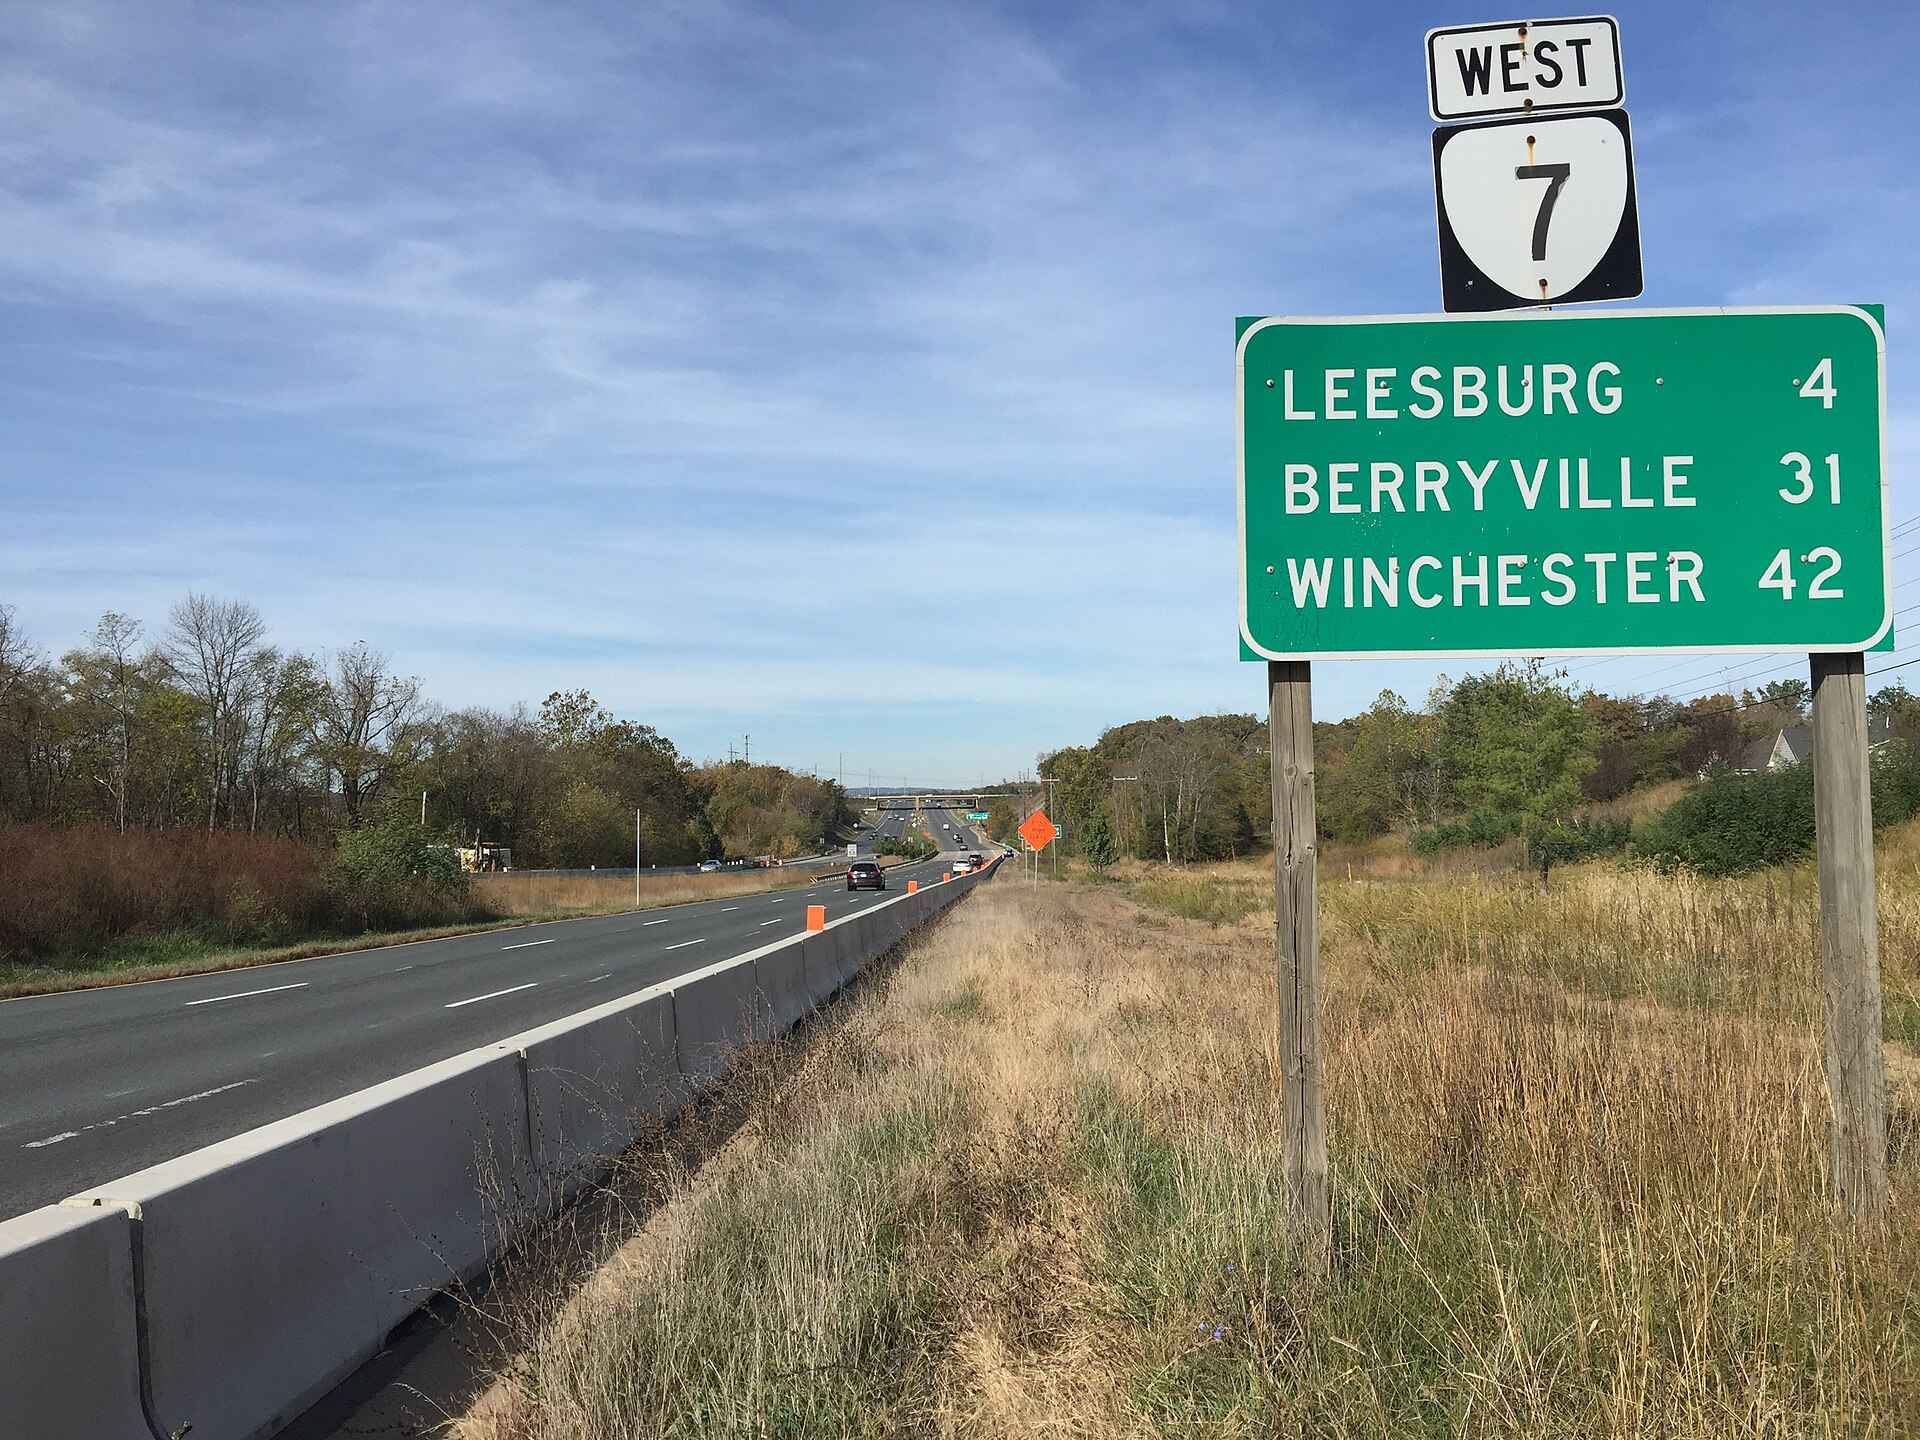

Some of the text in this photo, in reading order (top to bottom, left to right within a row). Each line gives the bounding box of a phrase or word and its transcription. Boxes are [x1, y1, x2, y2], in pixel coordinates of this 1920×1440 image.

[1455, 38, 1592, 96] WEST
[1515, 163, 1570, 261] 7
[1285, 358, 1837, 420] LEESBURG 4
[1285, 452, 1840, 514] BERRYVILLE 31
[1287, 547, 1843, 608] WINCHESTER 42
